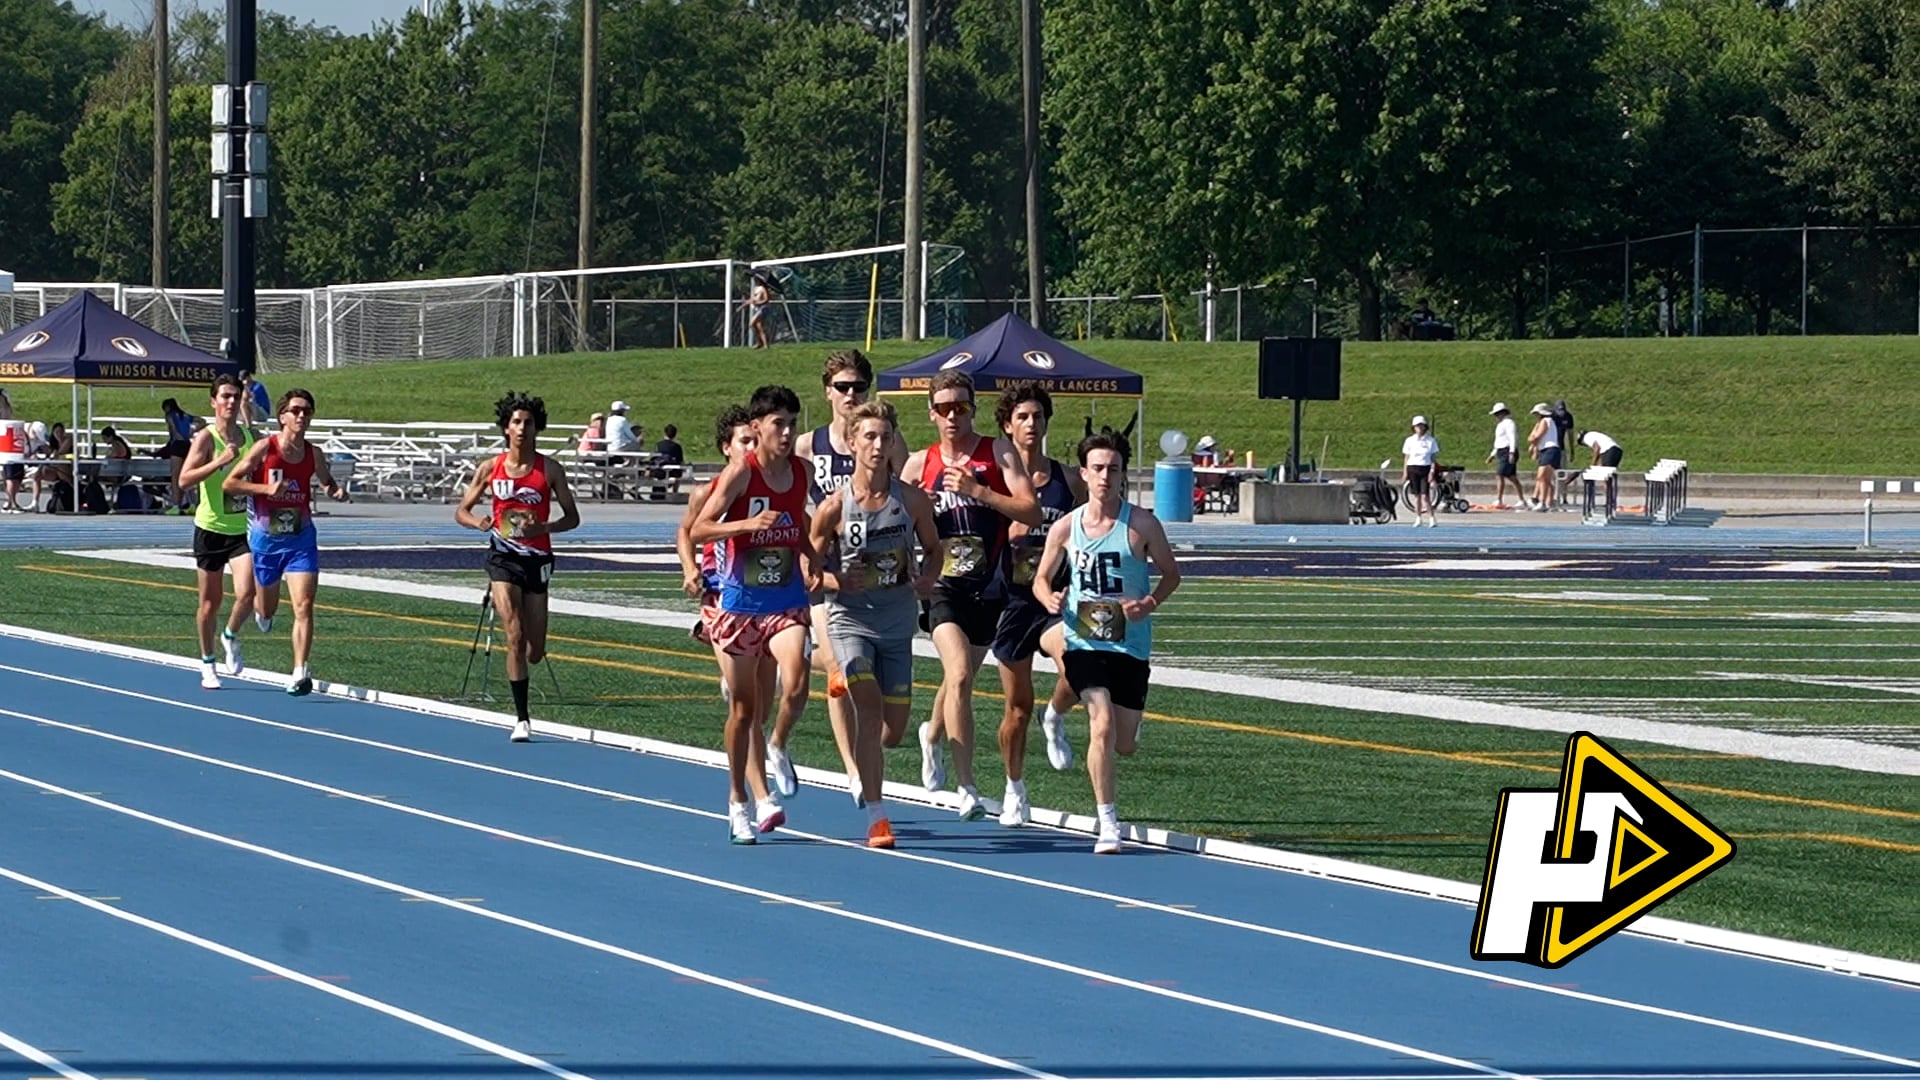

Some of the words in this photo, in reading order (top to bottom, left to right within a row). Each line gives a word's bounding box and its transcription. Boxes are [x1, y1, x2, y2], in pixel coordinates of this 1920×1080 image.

[99, 364, 157, 377] WINDSOR
[161, 365, 217, 380] LANCERS
[1059, 379, 1118, 392] LANCERS
[818, 456, 827, 479] 3
[272, 470, 279, 482] 1
[497, 481, 509, 492] 11
[754, 499, 765, 517] 2
[850, 522, 862, 547] 8
[1074, 550, 1090, 570] 13
[758, 572, 781, 584] 635
[878, 574, 897, 585] 144
